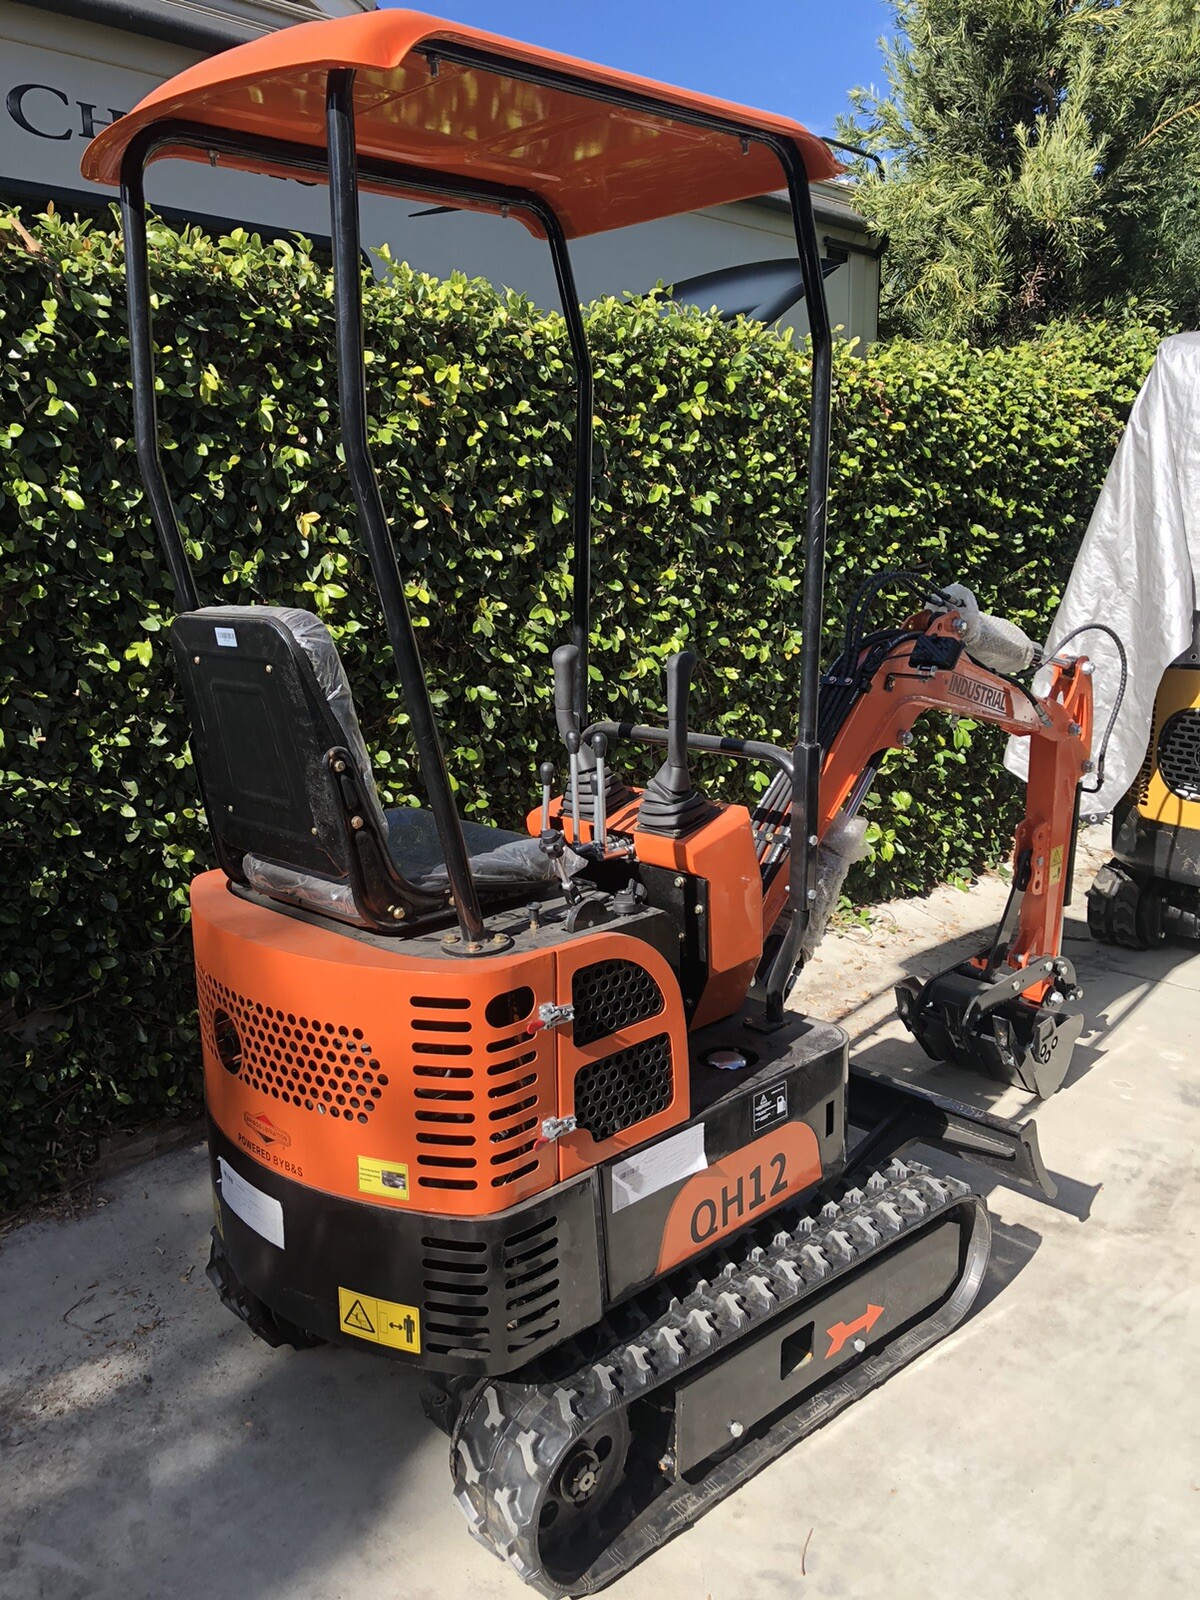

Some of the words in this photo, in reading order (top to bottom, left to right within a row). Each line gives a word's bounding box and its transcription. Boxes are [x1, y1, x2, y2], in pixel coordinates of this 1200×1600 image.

[950, 674, 1006, 711] INDUSTRIAL
[237, 1132, 271, 1162] POWERED
[690, 1152, 788, 1244] QH12
